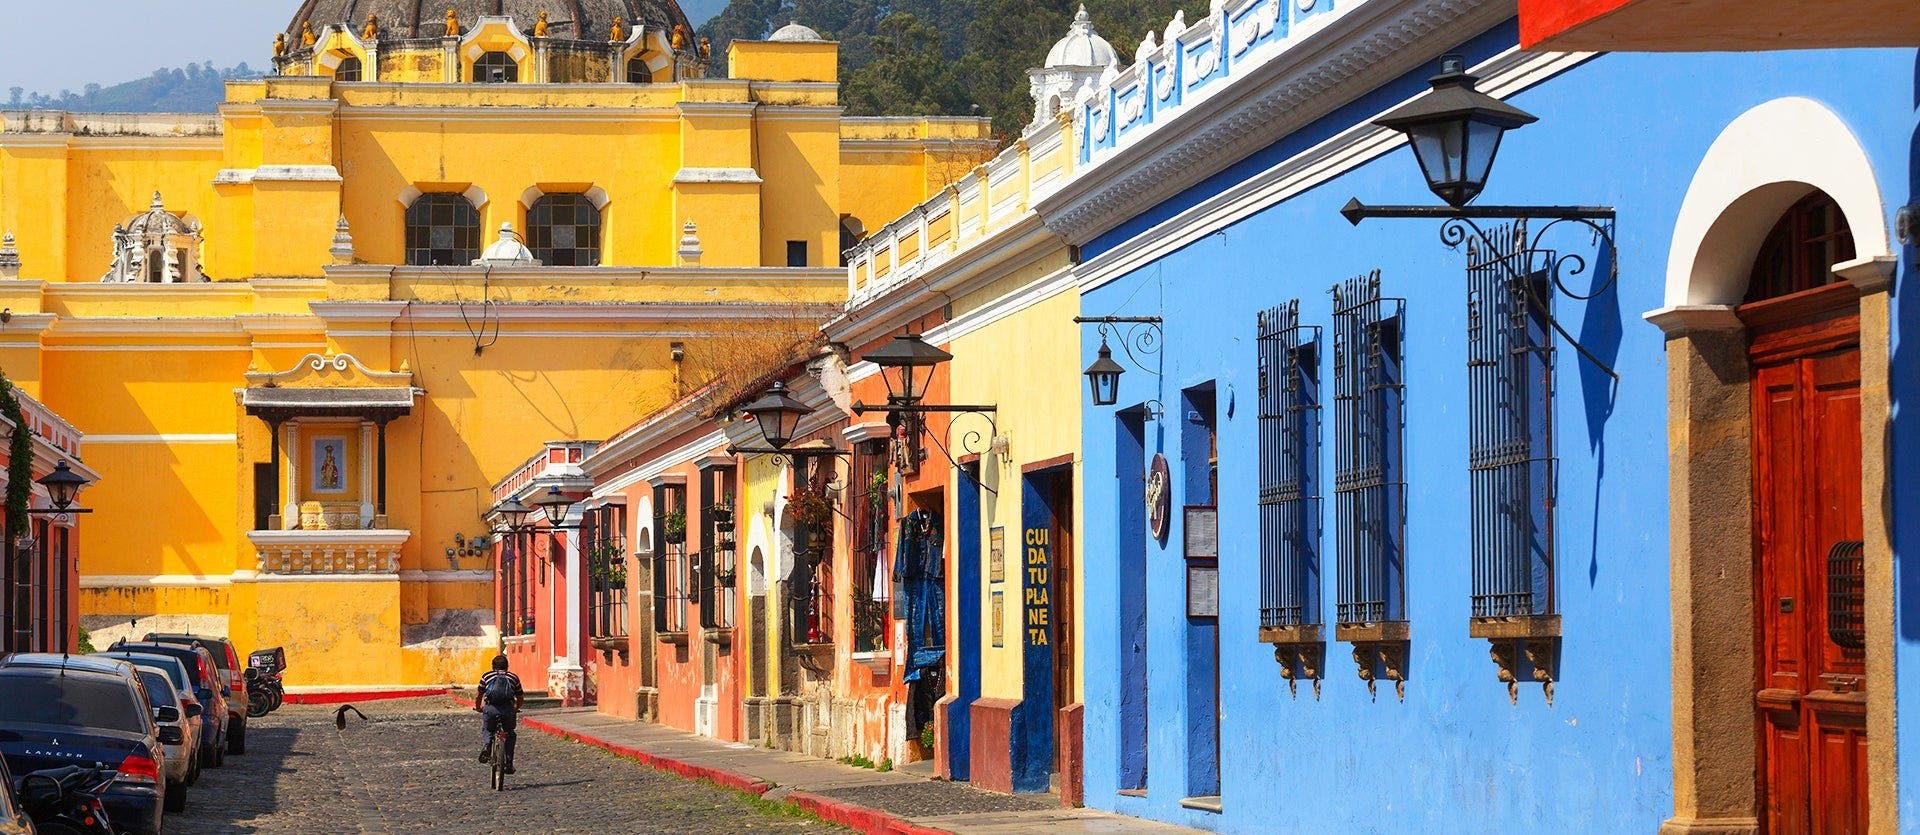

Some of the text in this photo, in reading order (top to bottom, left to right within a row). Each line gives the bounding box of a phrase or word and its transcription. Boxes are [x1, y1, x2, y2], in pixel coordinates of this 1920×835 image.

[1026, 529, 1049, 545] CUI
[1028, 548, 1047, 564] DA
[1028, 568, 1048, 584] TU
[1026, 588, 1049, 605] PLA
[1029, 609, 1048, 625] NE
[1029, 629, 1048, 645] TA
[25, 749, 83, 758] LANCER
